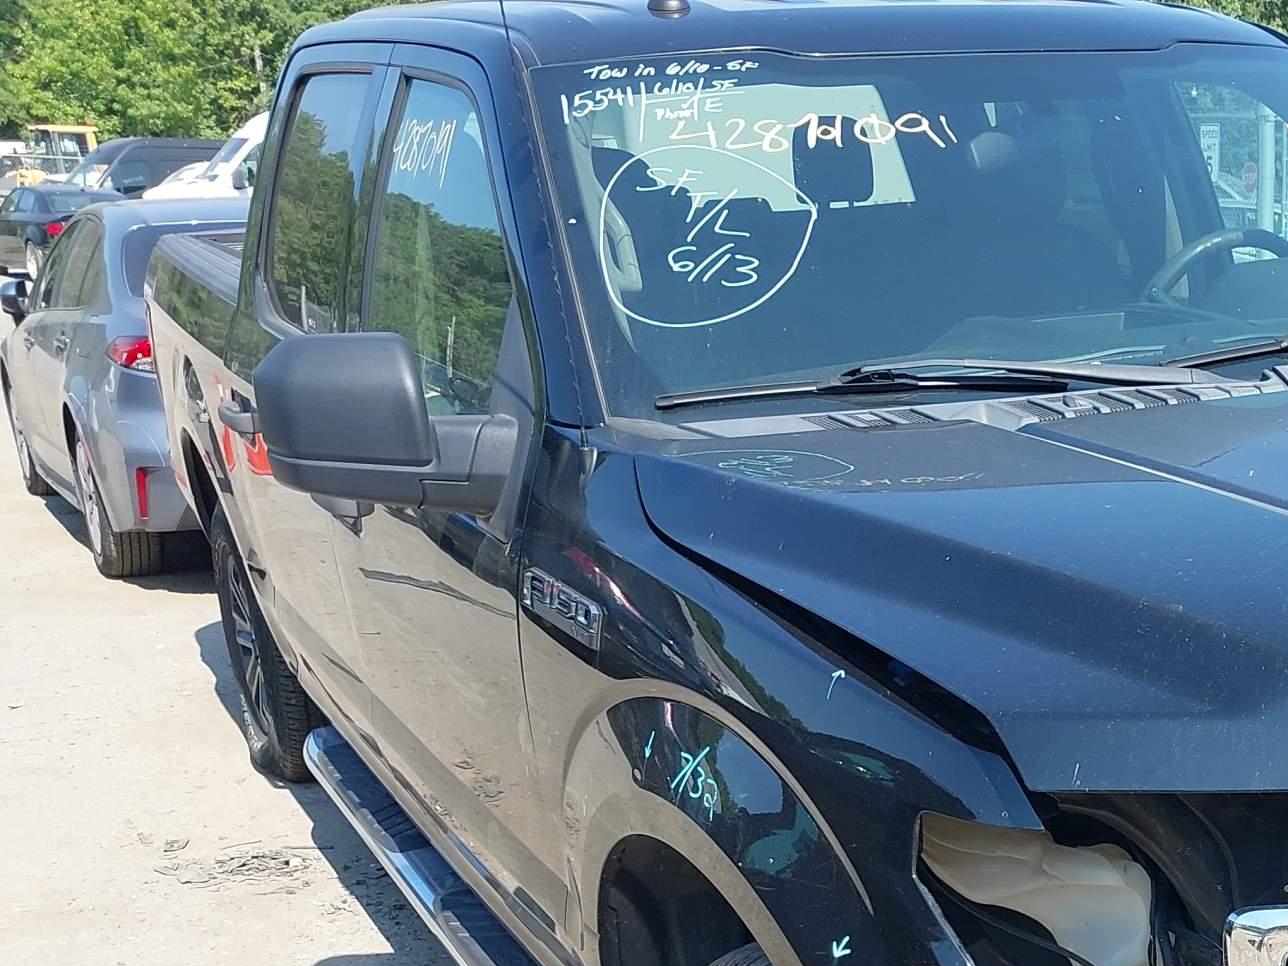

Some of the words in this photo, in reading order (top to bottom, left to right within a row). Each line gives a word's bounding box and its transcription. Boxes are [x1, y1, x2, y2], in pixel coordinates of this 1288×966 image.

[583, 64, 628, 80] Tow
[634, 63, 656, 77] in
[635, 168, 705, 196] SF
[667, 242, 760, 287] 6/13
